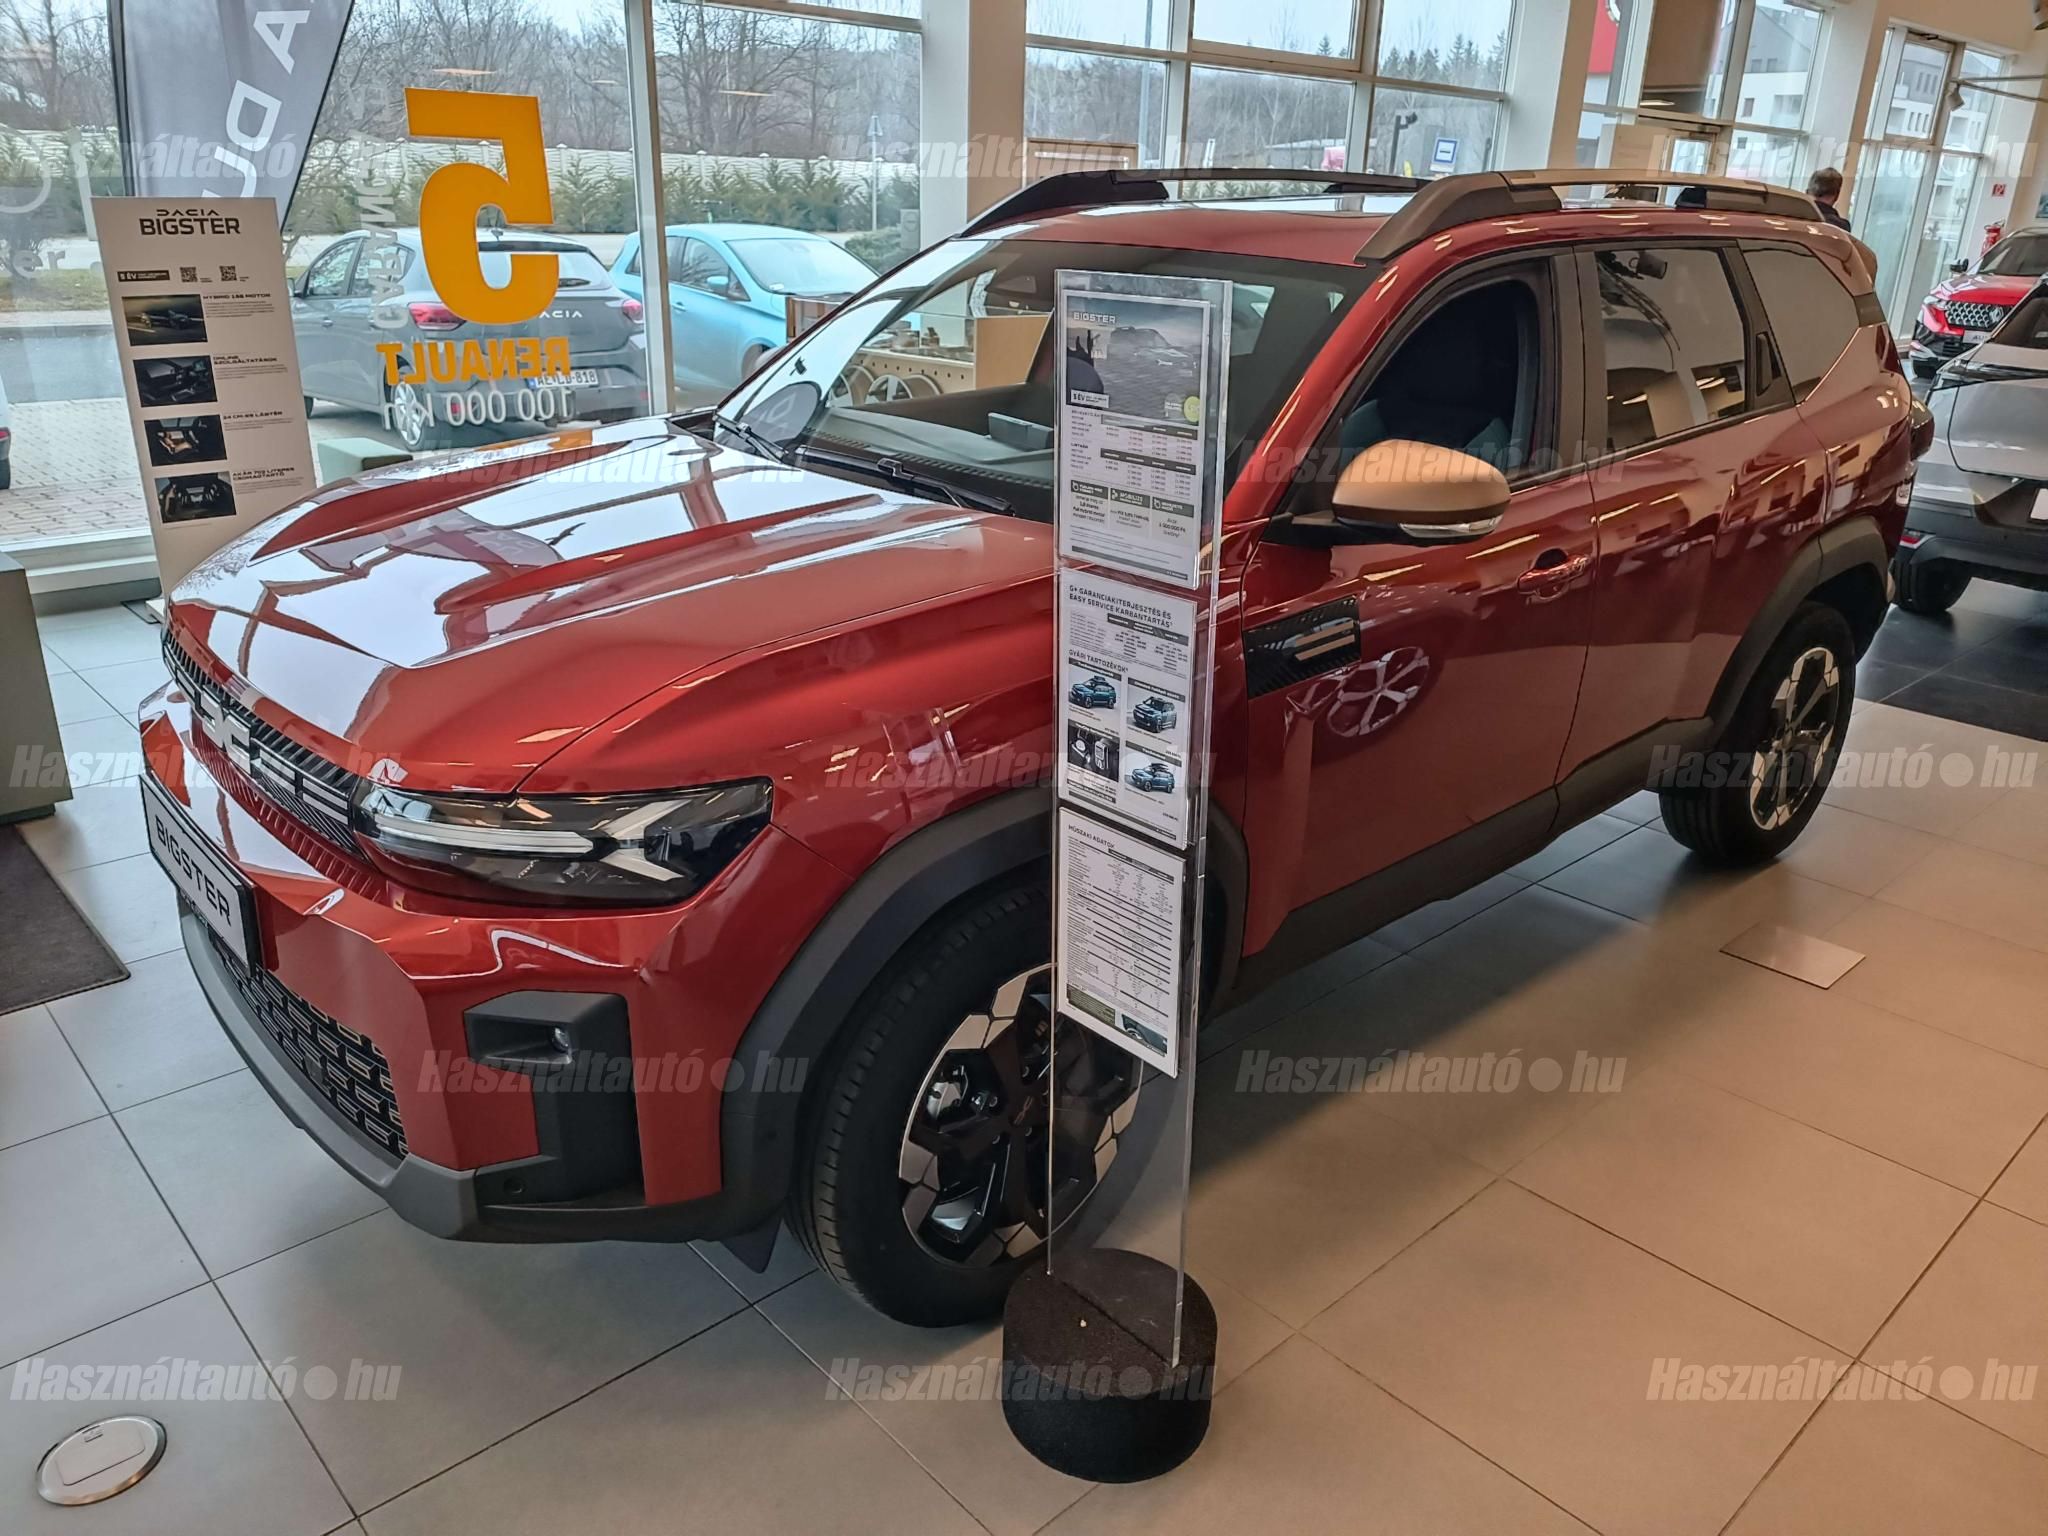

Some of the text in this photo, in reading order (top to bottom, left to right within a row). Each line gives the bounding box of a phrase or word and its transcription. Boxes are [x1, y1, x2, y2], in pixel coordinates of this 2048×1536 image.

[156, 208, 220, 217] DACIA
[139, 217, 241, 235] BIGSTER
[538, 309, 583, 319] ACIA
[1069, 593, 1086, 604] EASY
[1088, 598, 1114, 612] SERVICE
[1079, 588, 1161, 617] GARANCIAKITERJESZTÉS
[155, 815, 231, 926] BIGSTER
